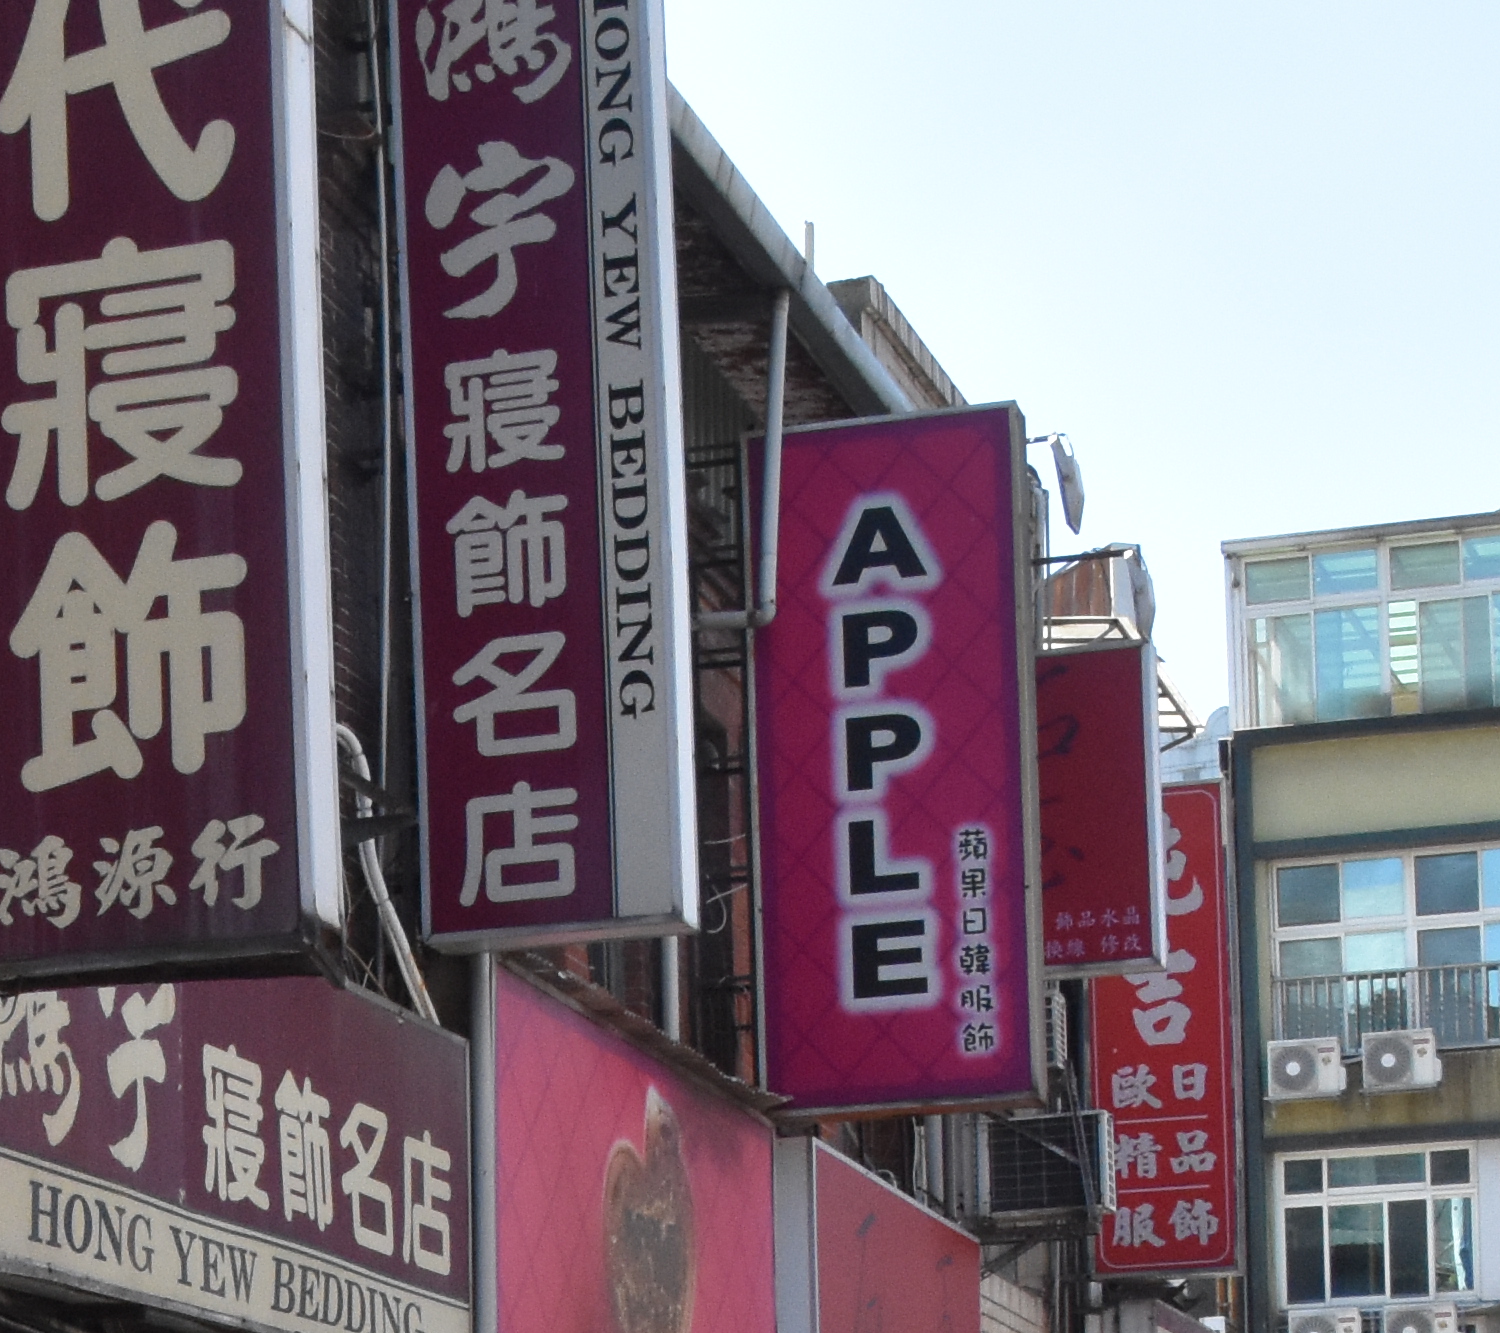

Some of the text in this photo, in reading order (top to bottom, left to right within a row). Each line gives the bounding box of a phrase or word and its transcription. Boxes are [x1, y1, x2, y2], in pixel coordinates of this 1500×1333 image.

[601, 192, 644, 350] YEW
[609, 382, 656, 719] BEDDING
[831, 506, 930, 1000] APPLE
[957, 828, 997, 1056] 蘋果日韓服飾
[1111, 1062, 1209, 1109] 歐日
[1114, 1131, 1218, 1180] 精品
[27, 1179, 154, 1274] HONG
[168, 1224, 259, 1303] YEW
[1112, 1199, 1220, 1249] 服飾
